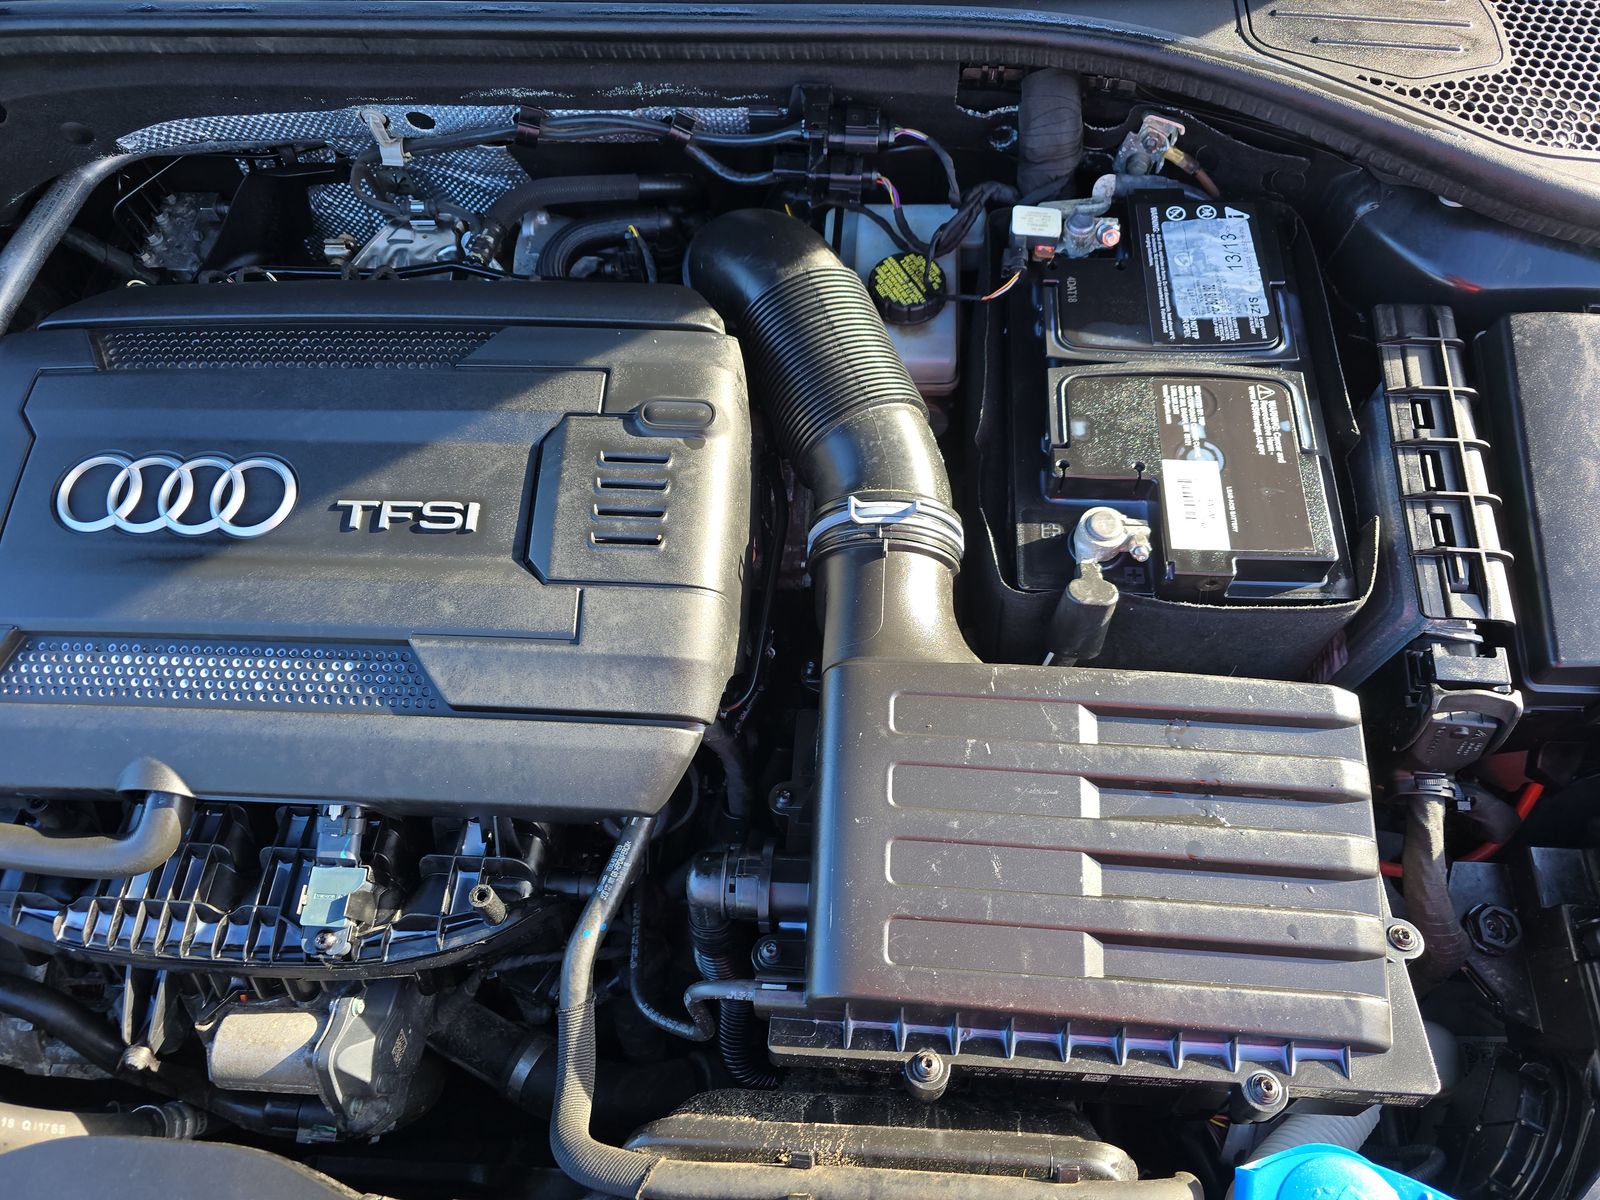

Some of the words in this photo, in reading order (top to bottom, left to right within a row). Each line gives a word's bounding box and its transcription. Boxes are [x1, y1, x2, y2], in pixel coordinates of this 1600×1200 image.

[1221, 233, 1243, 270] 13/13
[1189, 320, 1198, 330] NOT
[1267, 400, 1280, 430] WARNING:
[1265, 436, 1275, 451] Harm
[1272, 432, 1283, 451] Cancer
[1276, 451, 1286, 463] and
[336, 499, 481, 533] TFSI
[1229, 510, 1238, 532] BATTERY
